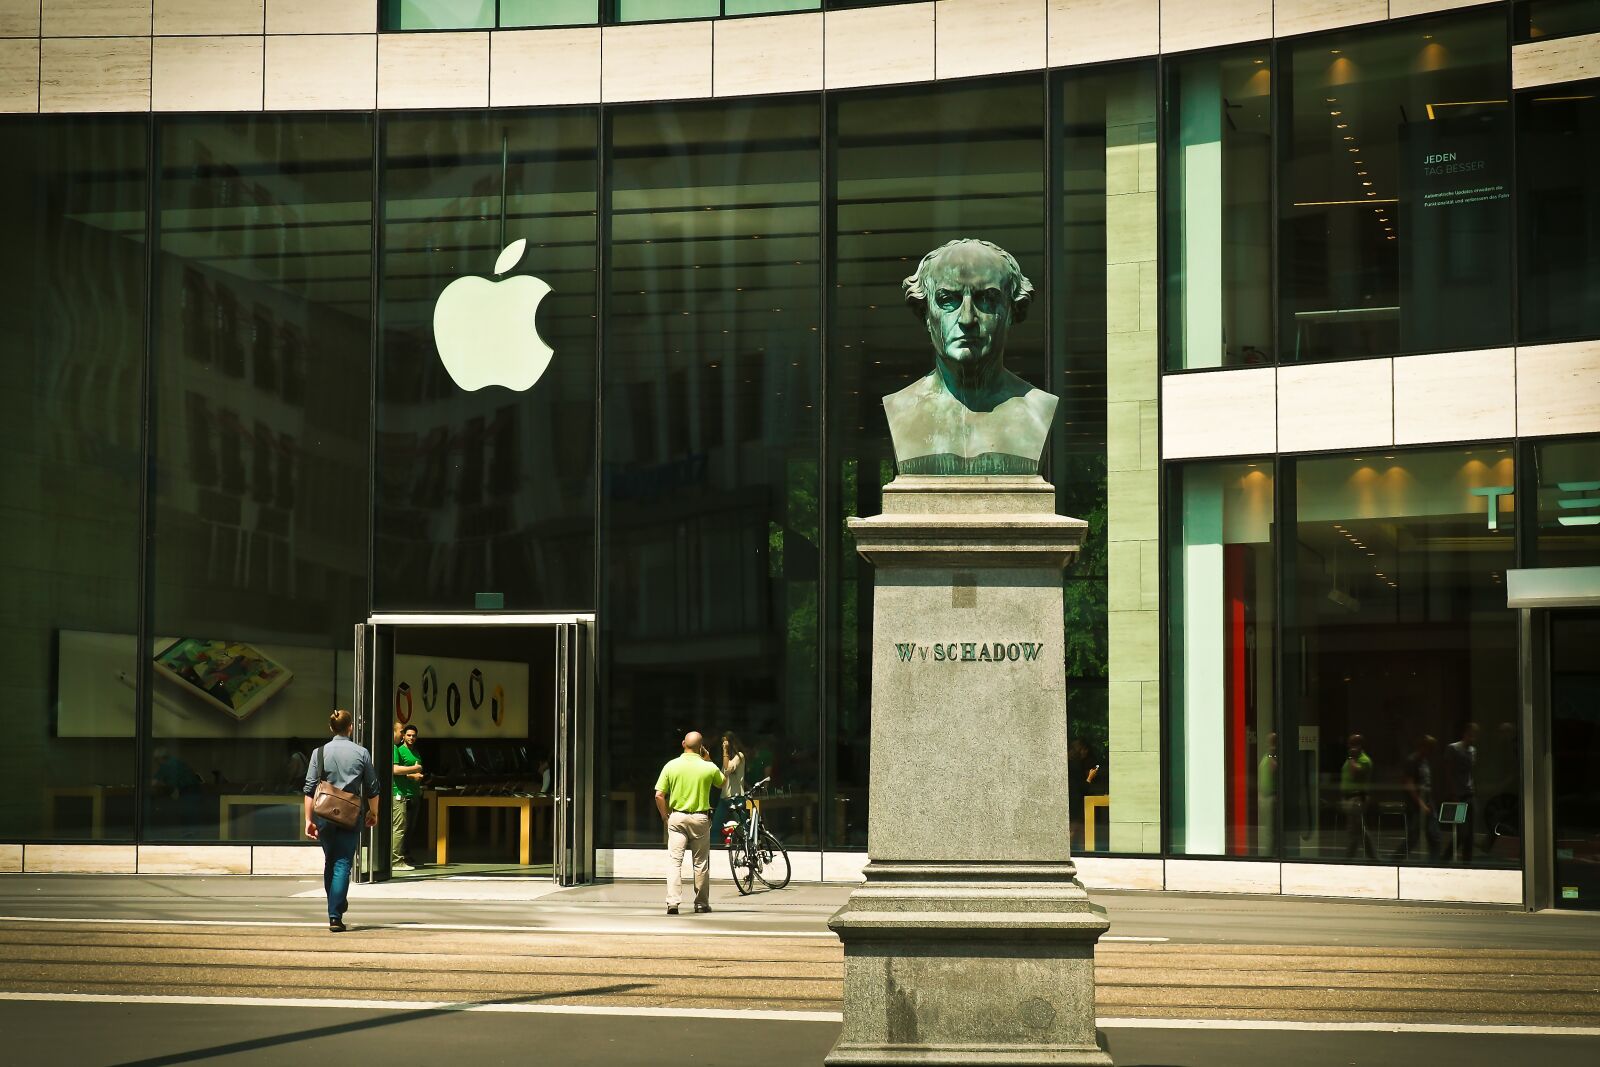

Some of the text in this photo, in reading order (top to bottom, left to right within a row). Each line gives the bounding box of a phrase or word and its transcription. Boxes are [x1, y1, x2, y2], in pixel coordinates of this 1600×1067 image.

[1424, 152, 1457, 164] JEDEN
[1424, 160, 1485, 176] TAG BESSER
[895, 642, 916, 662] W
[933, 642, 1044, 662] SCHADOW
